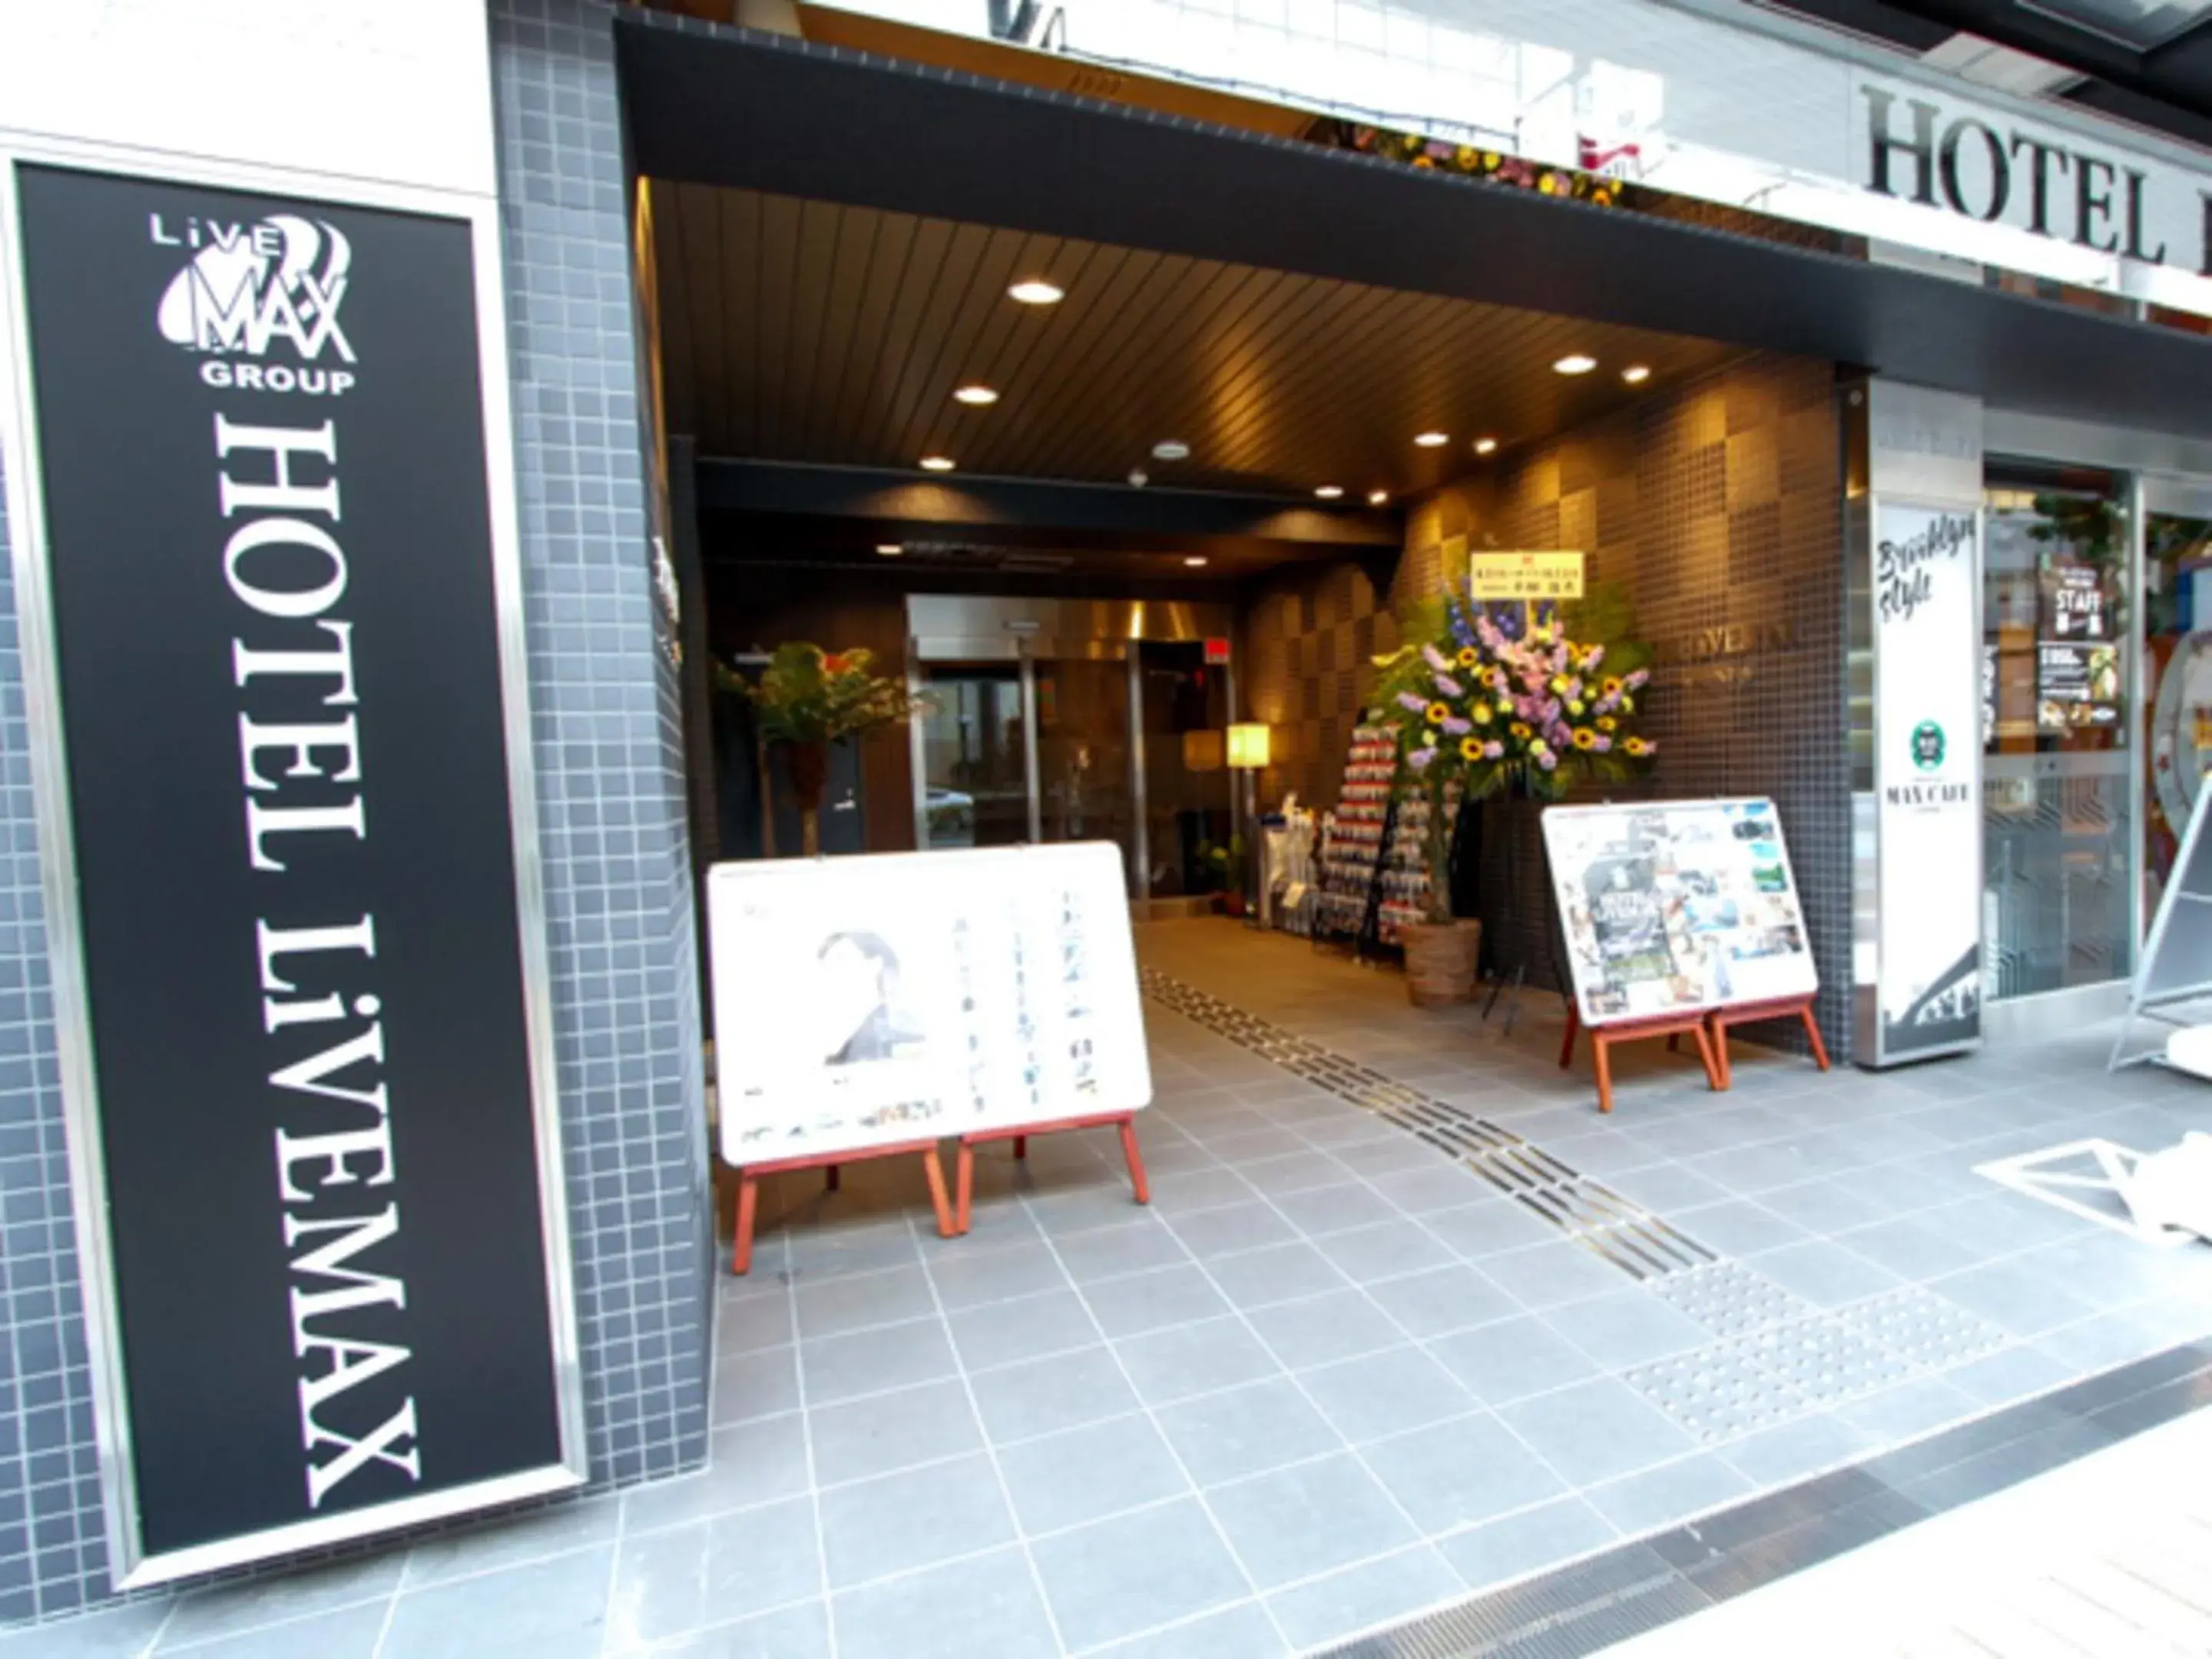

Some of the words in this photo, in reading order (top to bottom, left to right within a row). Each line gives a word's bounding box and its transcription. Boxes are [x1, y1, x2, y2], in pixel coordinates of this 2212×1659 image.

[1860, 84, 2165, 265] HOTEL
[188, 263, 358, 364] MAX
[200, 360, 356, 396] GROUP
[214, 412, 366, 872] HOTEL
[256, 912, 421, 1509] LiVEMAX
